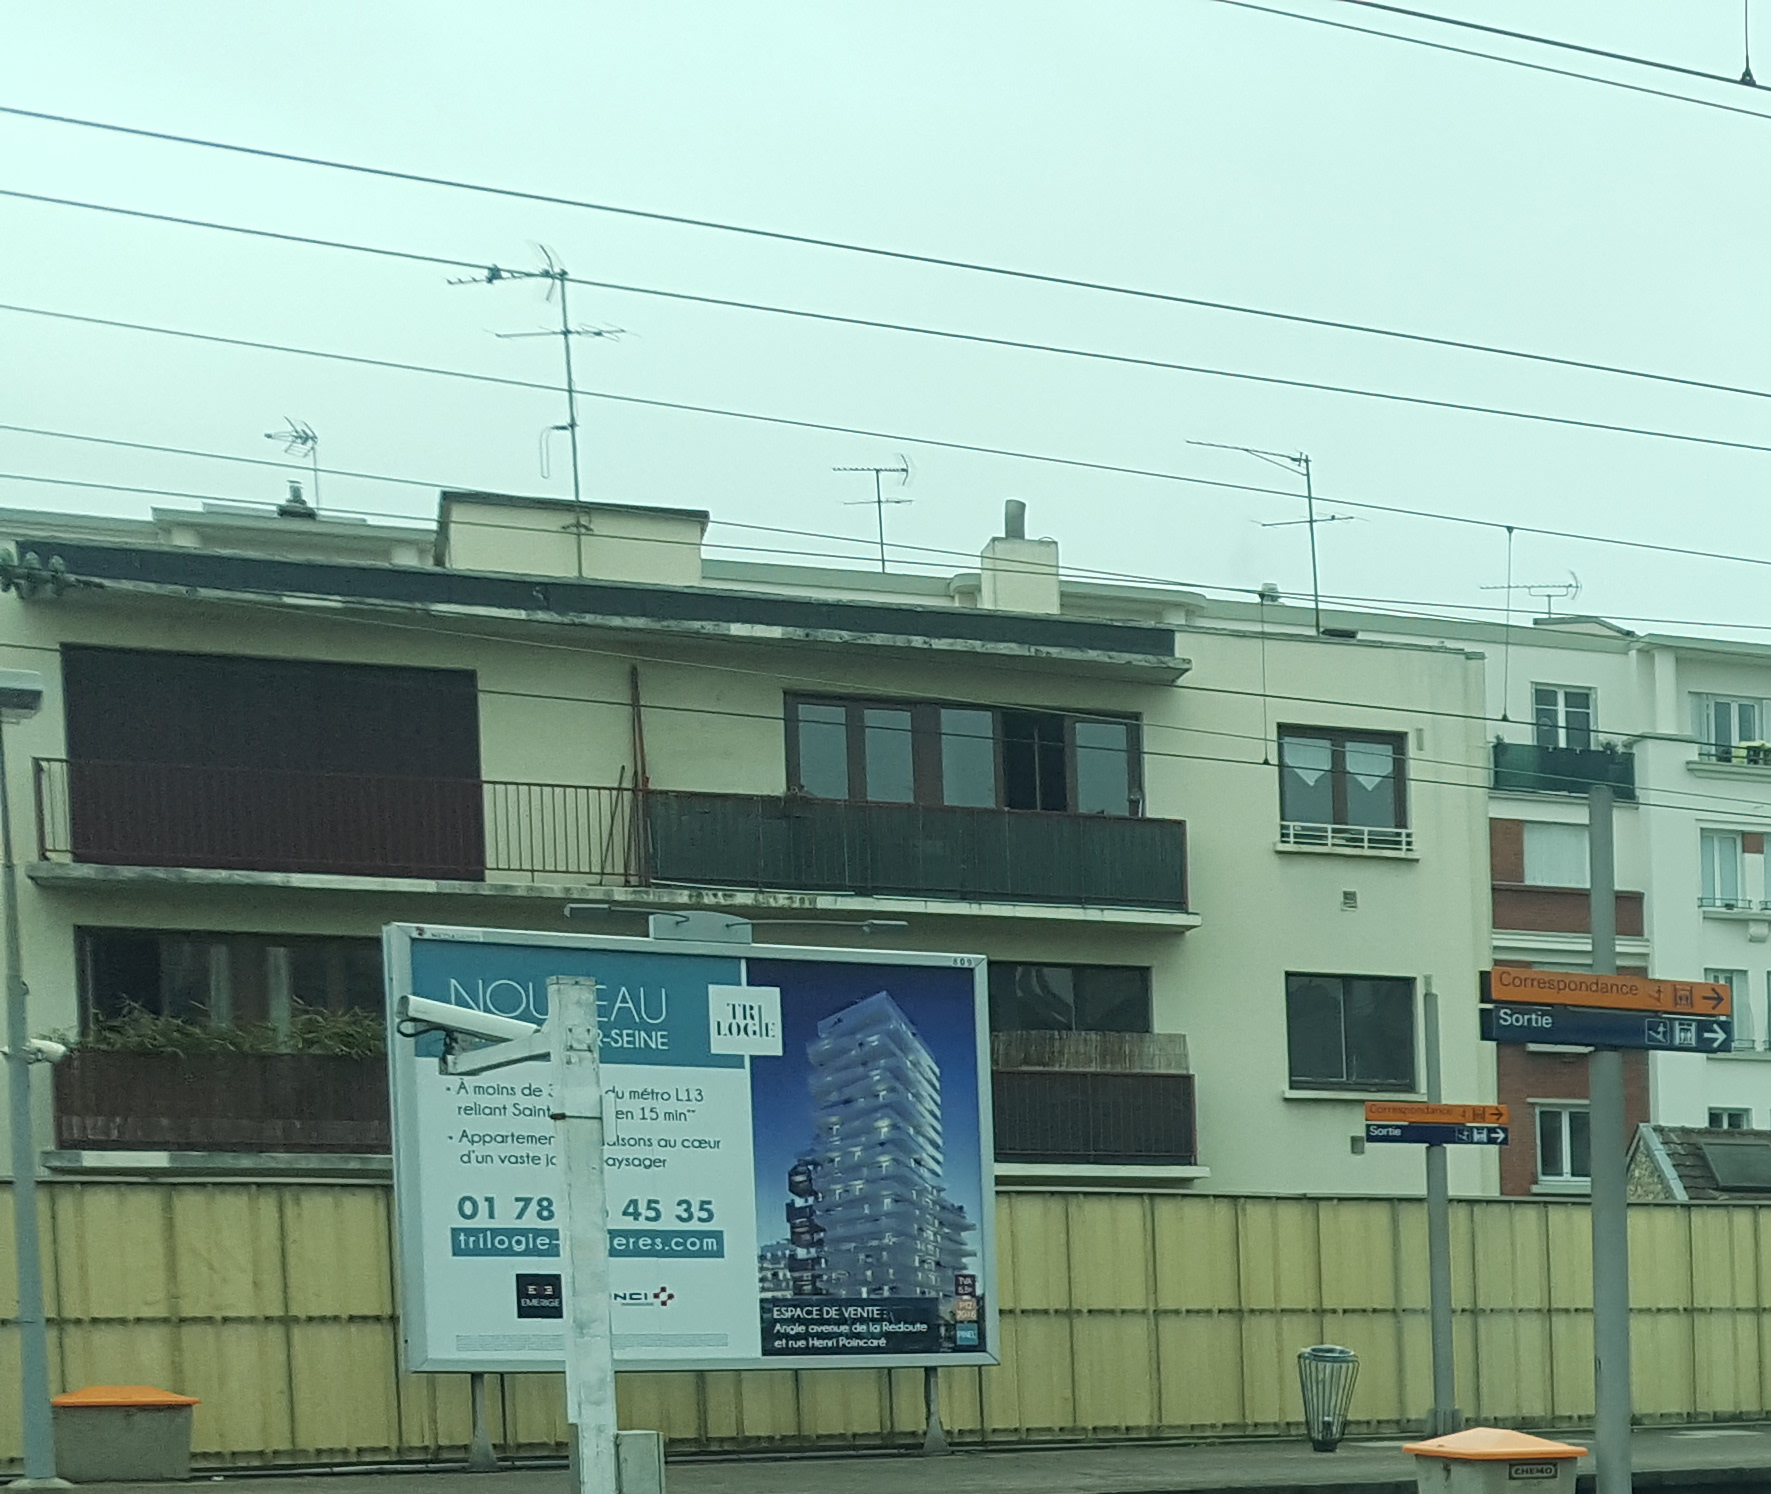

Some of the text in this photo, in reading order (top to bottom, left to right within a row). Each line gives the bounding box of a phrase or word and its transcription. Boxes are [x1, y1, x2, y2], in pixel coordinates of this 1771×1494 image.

[952, 958, 973, 967] 809
[1499, 971, 1639, 997] Correspondance
[450, 977, 667, 1025] NOUEAU
[1499, 1009, 1553, 1029] Sortie
[456, 1078, 470, 1096] À
[473, 1082, 517, 1098] moins
[521, 1081, 543, 1098] de
[629, 1088, 671, 1102] métro
[675, 1088, 704, 1102] L13
[457, 1104, 507, 1118] reliant
[615, 1109, 634, 1120] en
[640, 1107, 659, 1121] 15
[1369, 1104, 1454, 1118] Correspondance
[1369, 1126, 1403, 1137] Sortie
[658, 1138, 677, 1148] au
[681, 1139, 721, 1149] cœur
[460, 1149, 494, 1165] d'un
[500, 1152, 541, 1166] vaste
[605, 1156, 667, 1169] aysager
[457, 1196, 496, 1220] 01
[514, 1196, 555, 1221] 78
[622, 1198, 662, 1222] 45
[675, 1198, 714, 1223] 35
[773, 1307, 820, 1319] ESPACE
[823, 1307, 840, 1319] DE
[842, 1307, 881, 1319] VENTE
[773, 1322, 928, 1335] Angle avenue de la Redoute
[774, 1336, 887, 1349] et rue Henri Poincaré
[1513, 1466, 1553, 1476] CHEMO
